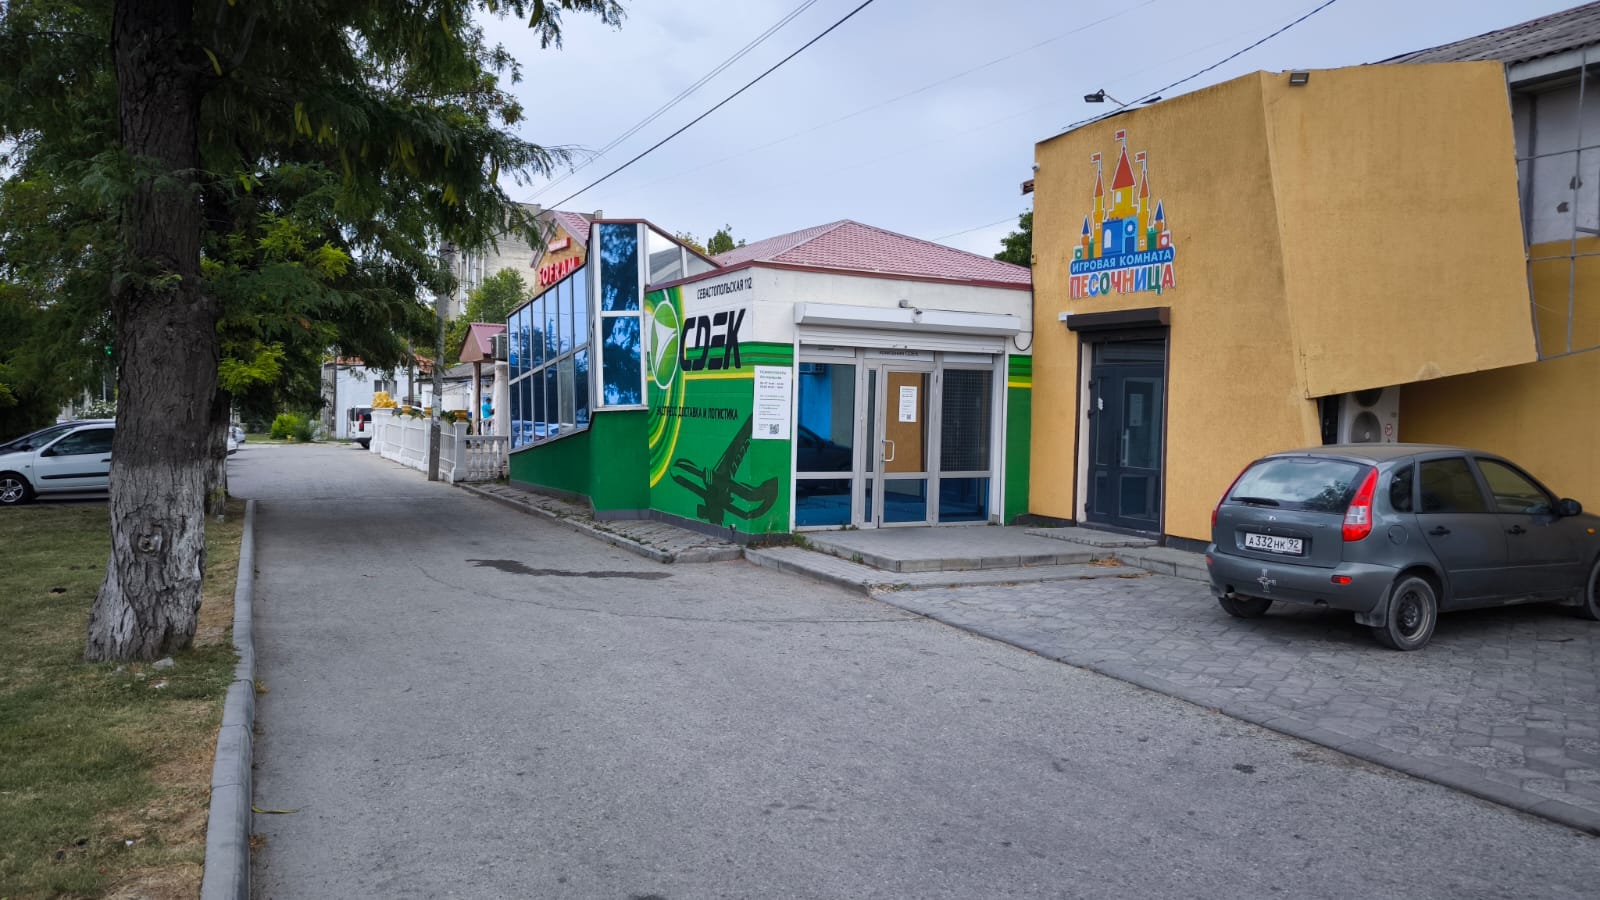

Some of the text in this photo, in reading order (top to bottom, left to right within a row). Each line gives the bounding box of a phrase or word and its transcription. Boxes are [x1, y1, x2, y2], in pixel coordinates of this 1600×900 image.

[1072, 249, 1172, 272] ИГРОВАЯ КОМНАТА
[697, 279, 744, 299] СЕВАСТОПОЛЬСКАЯ
[1069, 263, 1175, 299] ПЕСОЧНИЦА
[679, 308, 746, 372] CDEK
[1288, 539, 1299, 549] 92
